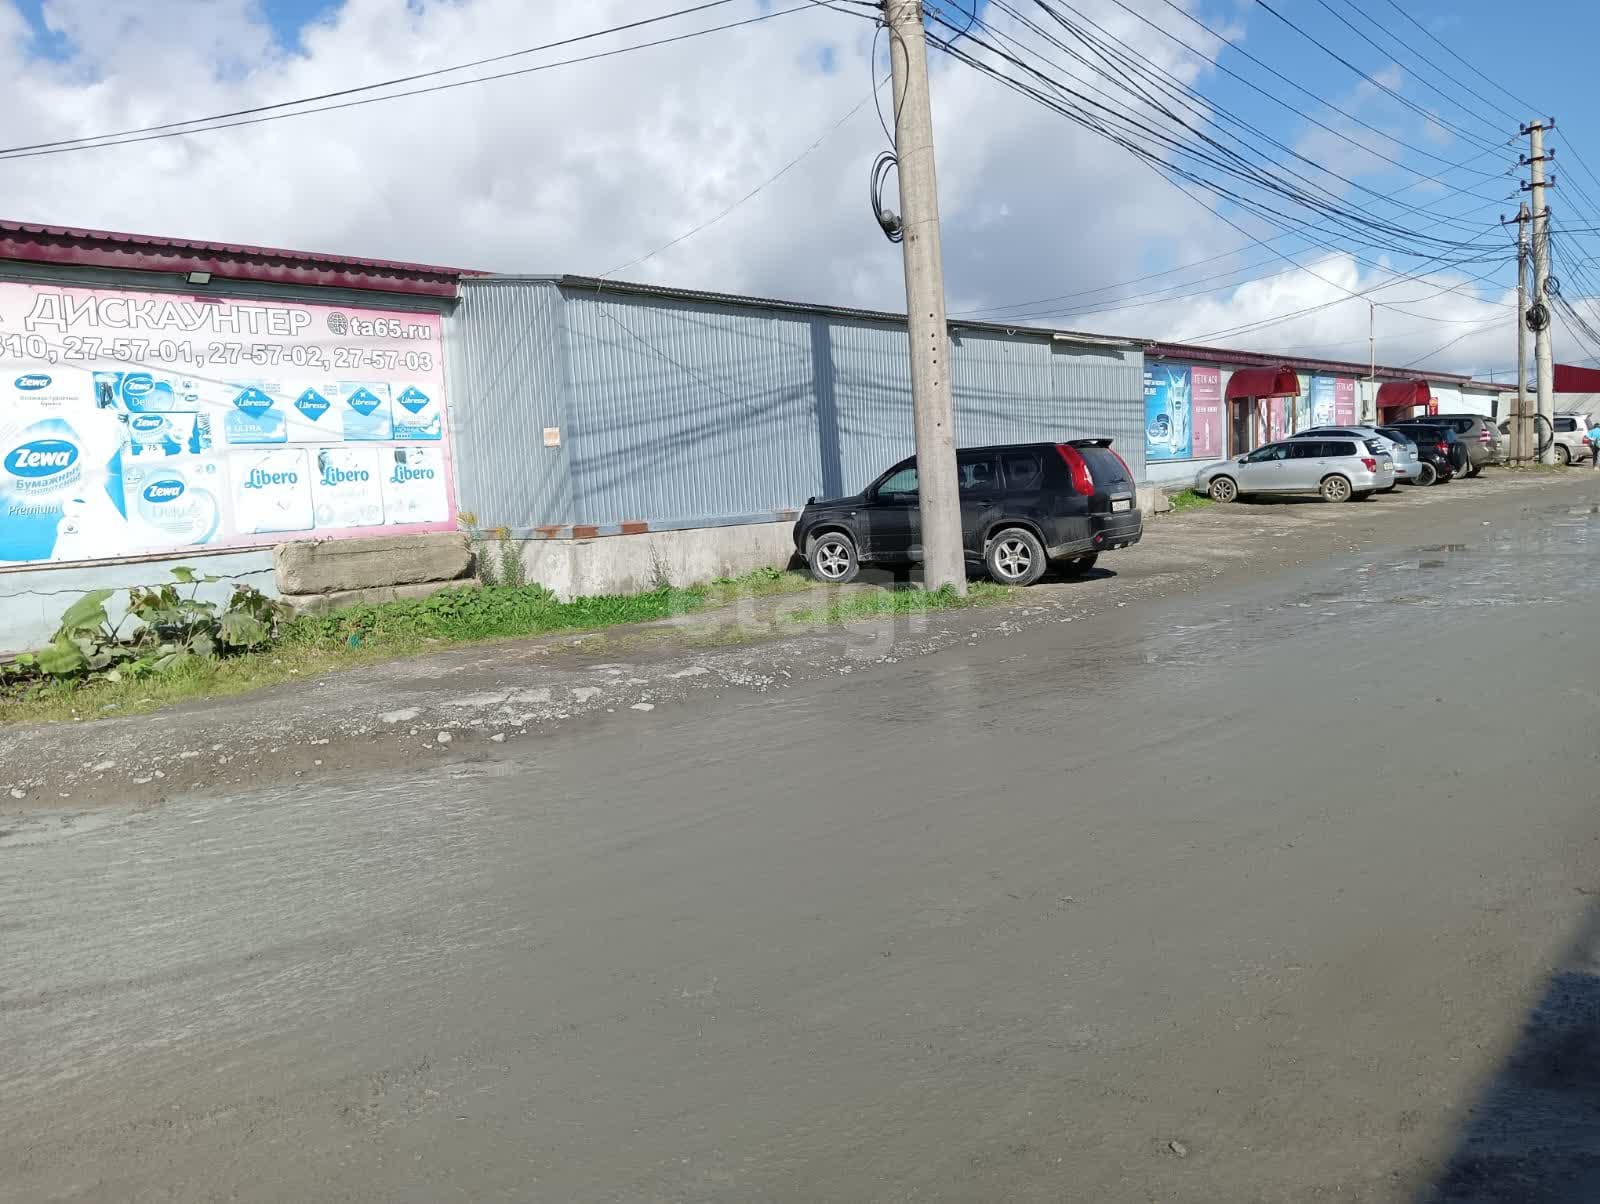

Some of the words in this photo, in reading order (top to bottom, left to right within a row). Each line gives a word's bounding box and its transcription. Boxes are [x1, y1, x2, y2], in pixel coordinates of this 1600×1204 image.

[24, 293, 312, 337] ДИСКАУНТЕР
[350, 316, 431, 340] ta65.ru
[333, 347, 433, 371] 27-57-03
[19, 377, 49, 388] Zewa
[15, 448, 72, 468] Zewa
[244, 467, 298, 489] Libero
[319, 464, 369, 486] Libero
[389, 464, 435, 484] Libero
[149, 483, 181, 498] Zewa
